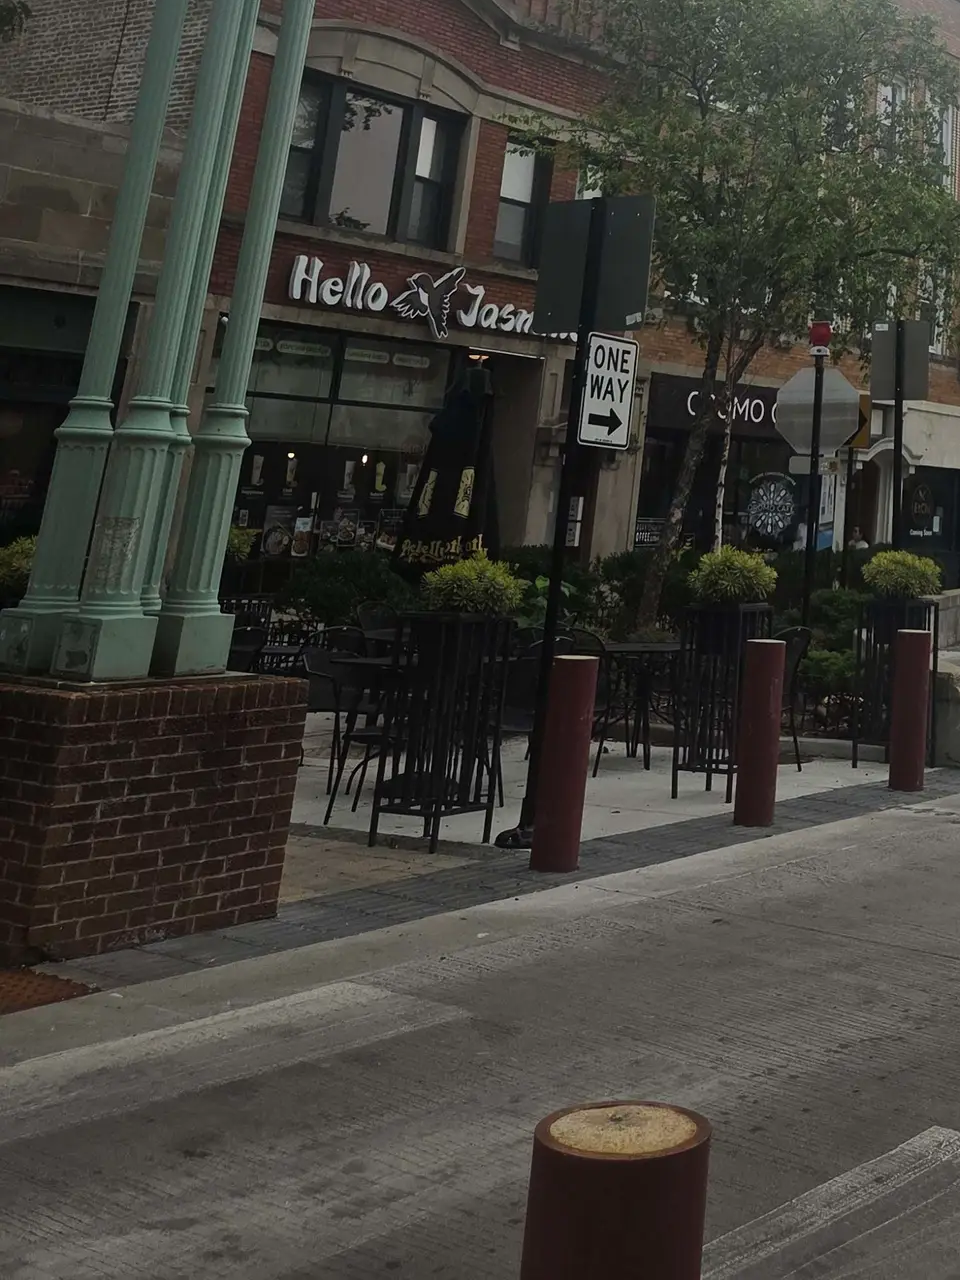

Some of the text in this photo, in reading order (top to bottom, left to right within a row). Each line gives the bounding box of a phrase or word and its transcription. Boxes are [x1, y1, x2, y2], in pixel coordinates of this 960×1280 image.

[289, 254, 578, 343] Hello Jasm
[594, 344, 631, 374] ONE
[590, 374, 629, 403] WAY
[687, 391, 765, 423] OMO
